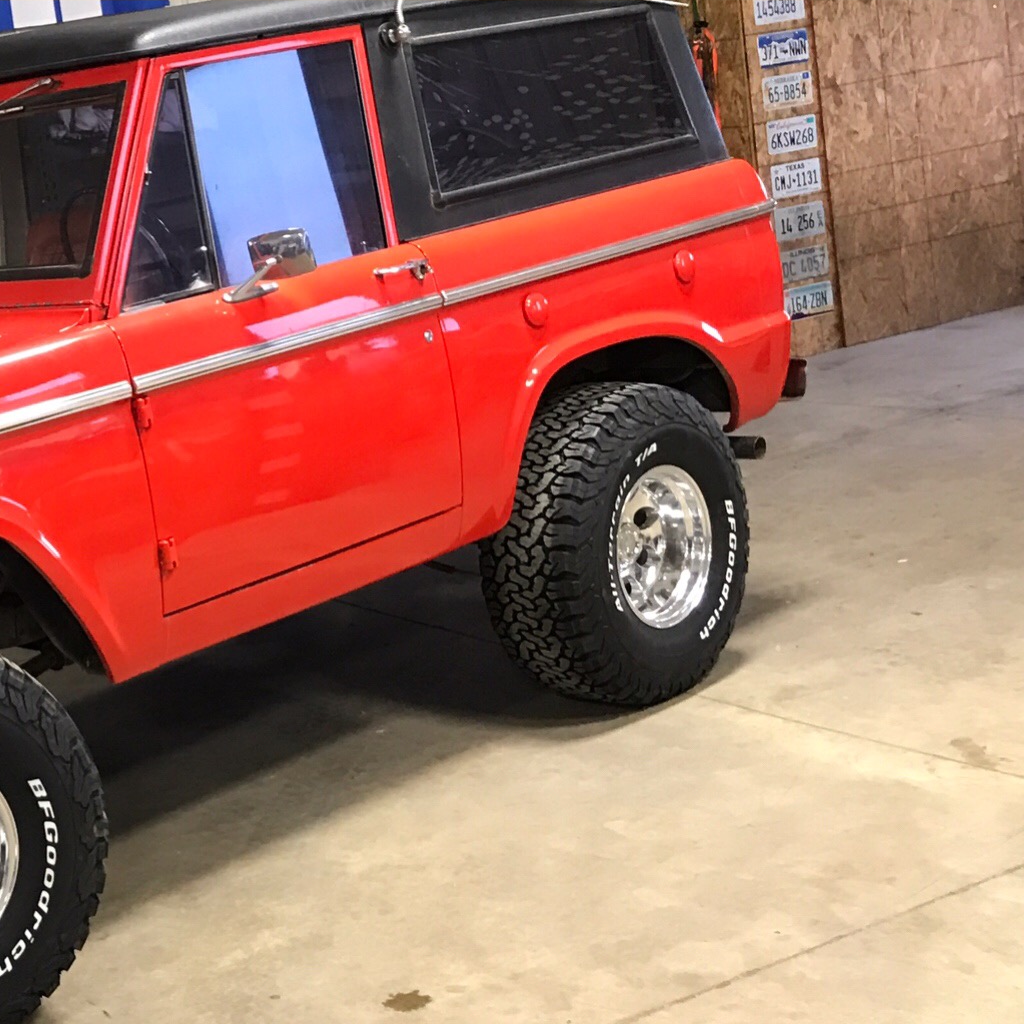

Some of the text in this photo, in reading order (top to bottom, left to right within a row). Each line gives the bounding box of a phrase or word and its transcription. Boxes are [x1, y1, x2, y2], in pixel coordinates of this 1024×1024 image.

[771, 127, 815, 150] 6KSW268
[785, 162, 805, 172] TEXAS
[781, 218, 792, 235] 14
[797, 213, 815, 232] 256
[634, 442, 658, 468] T/A
[699, 498, 738, 641] BFGoodrich
